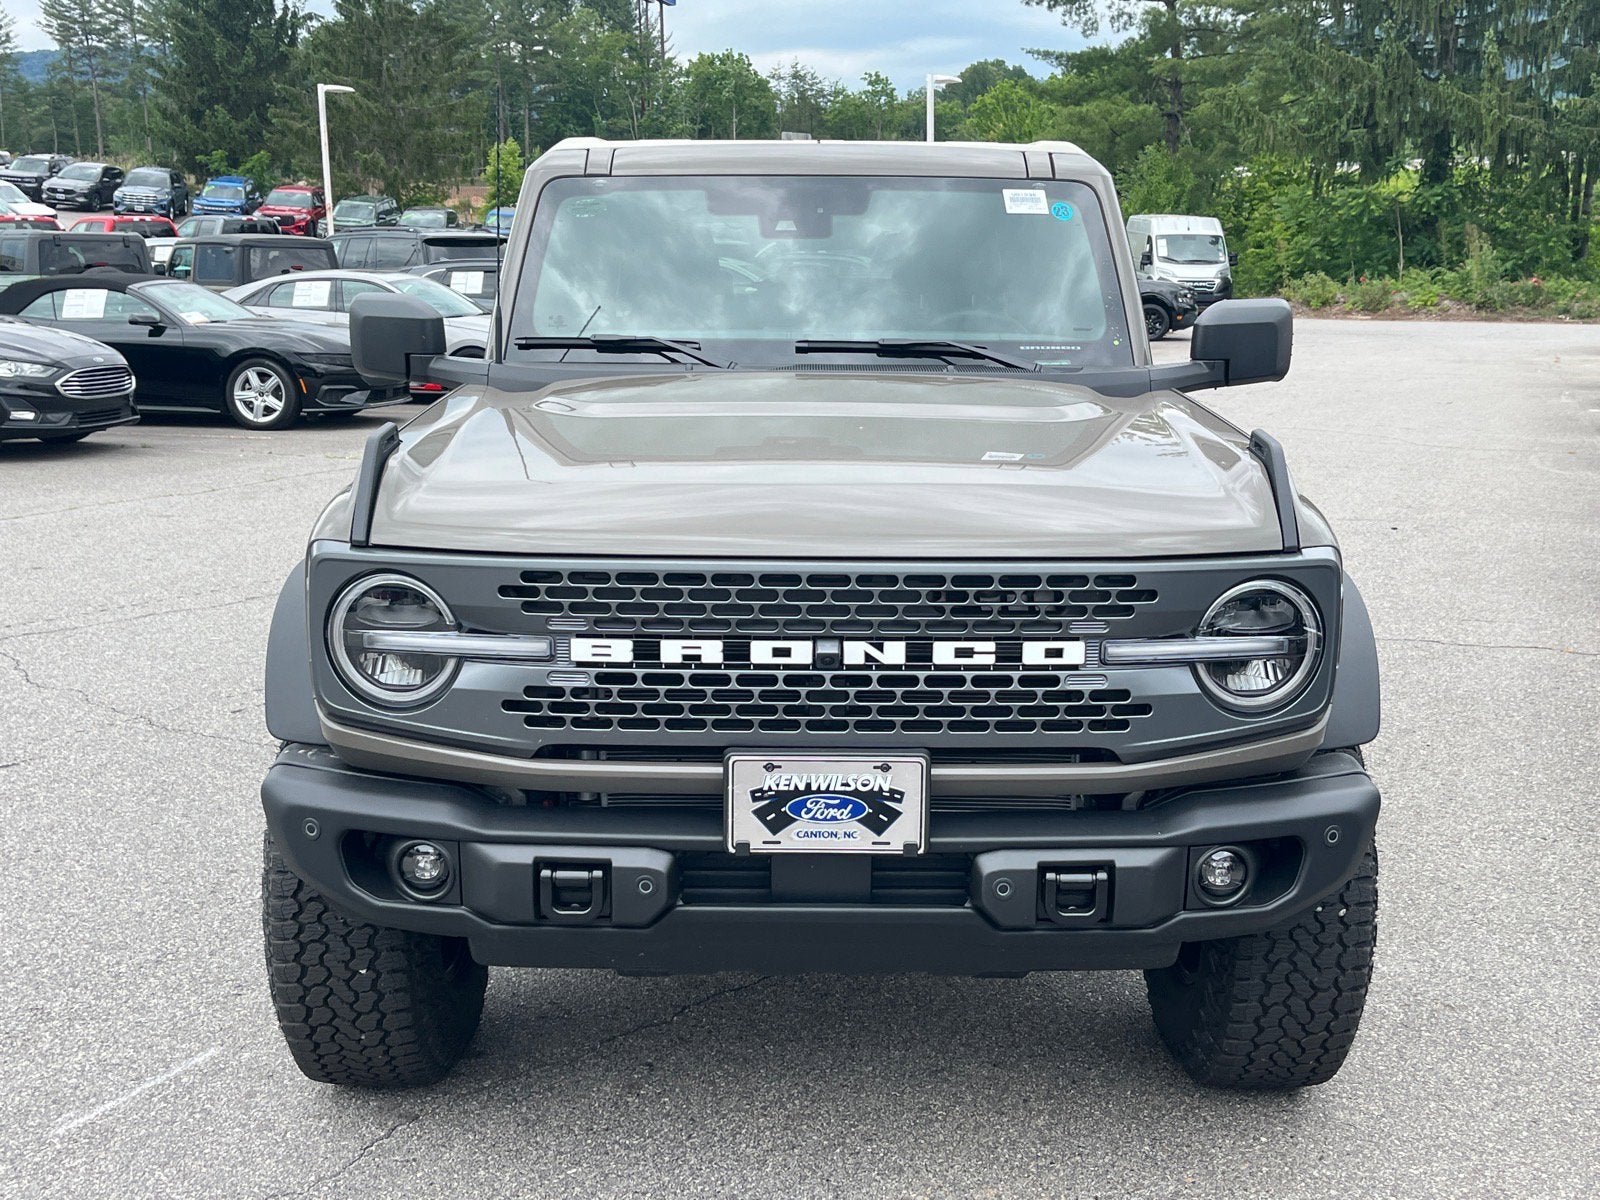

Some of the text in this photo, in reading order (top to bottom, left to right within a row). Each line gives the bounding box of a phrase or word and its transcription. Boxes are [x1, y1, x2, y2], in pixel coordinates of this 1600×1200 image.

[570, 637, 1086, 665] BRONCO
[762, 774, 893, 792] KEN WILSON
[800, 798, 853, 819] Ford
[796, 830, 859, 840] CANTON, NC
